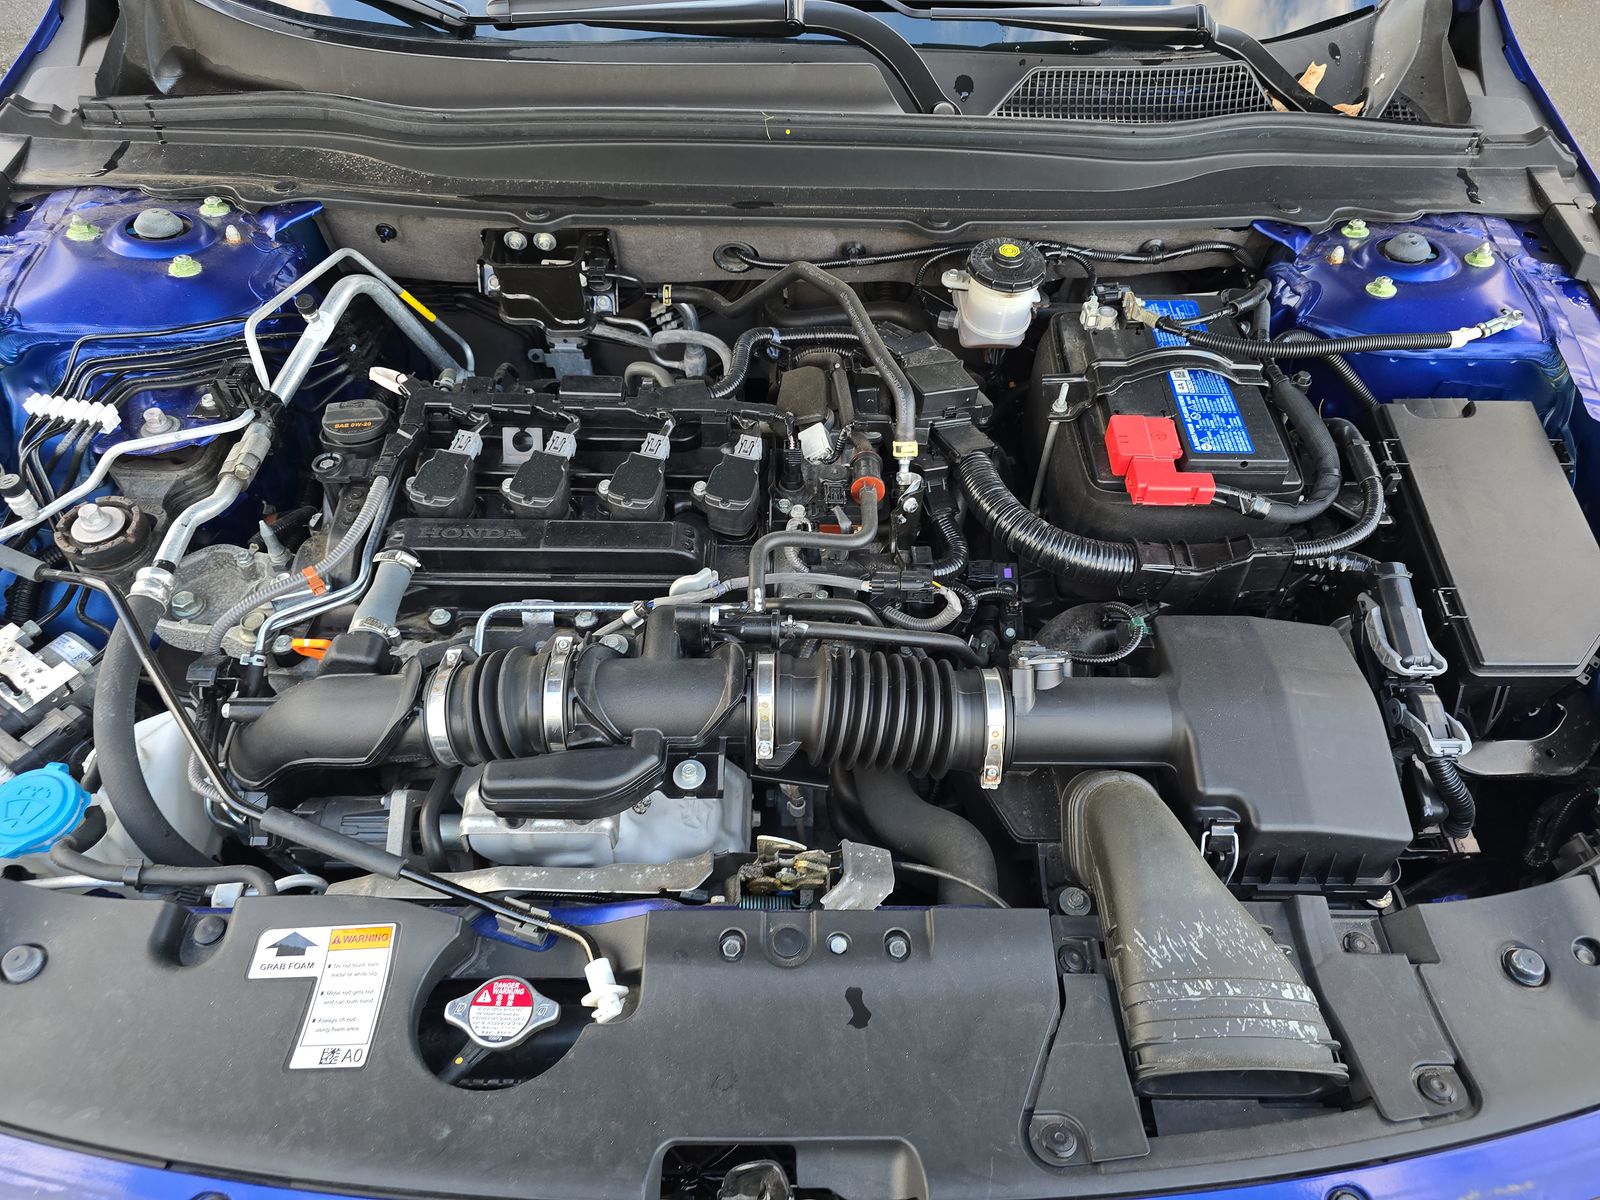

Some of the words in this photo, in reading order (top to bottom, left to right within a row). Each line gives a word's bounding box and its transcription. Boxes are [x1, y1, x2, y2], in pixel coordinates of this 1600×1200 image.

[417, 527, 527, 539] HONDA
[342, 933, 389, 944] WARNING
[259, 962, 286, 971] GRAB
[287, 961, 315, 970] FOAM
